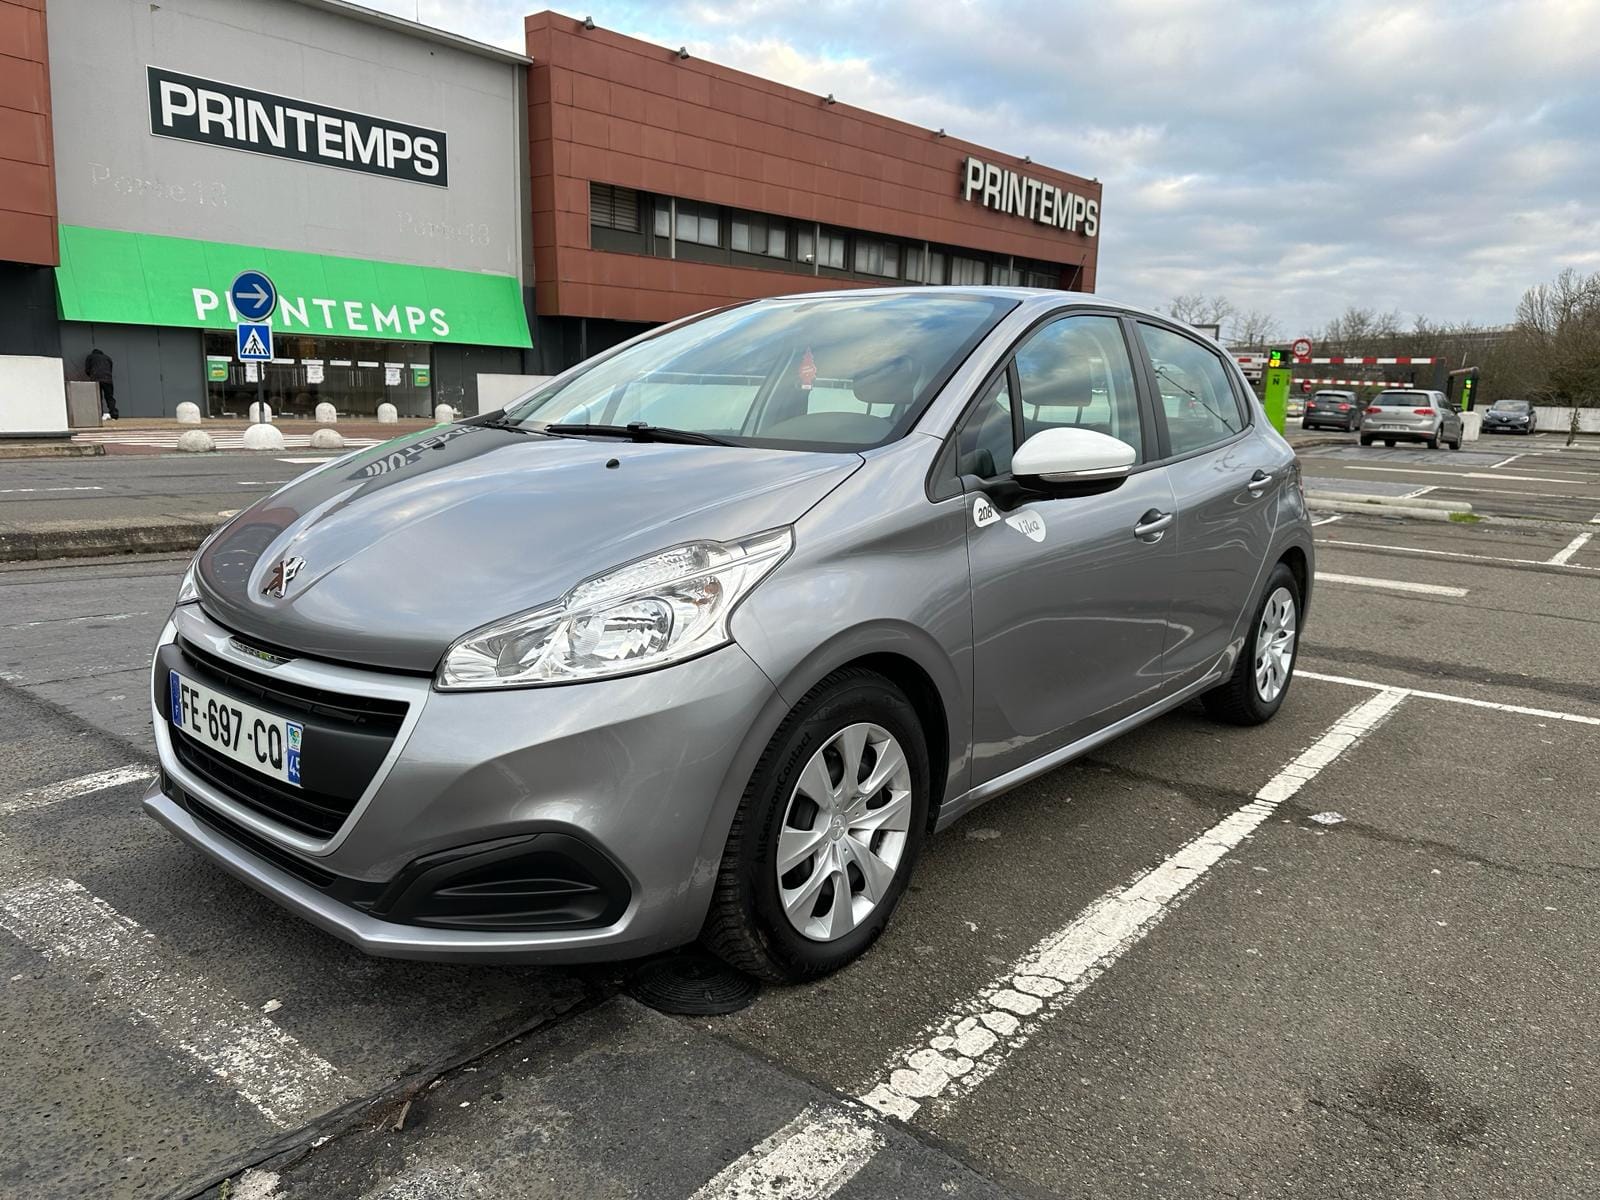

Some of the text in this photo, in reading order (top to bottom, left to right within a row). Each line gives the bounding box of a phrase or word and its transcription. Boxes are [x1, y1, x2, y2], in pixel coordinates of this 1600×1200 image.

[159, 80, 440, 177] PRINTEMPS
[964, 156, 1099, 237] PRINTEMPS
[191, 287, 450, 337] PNTEMPS
[978, 506, 993, 521] 208
